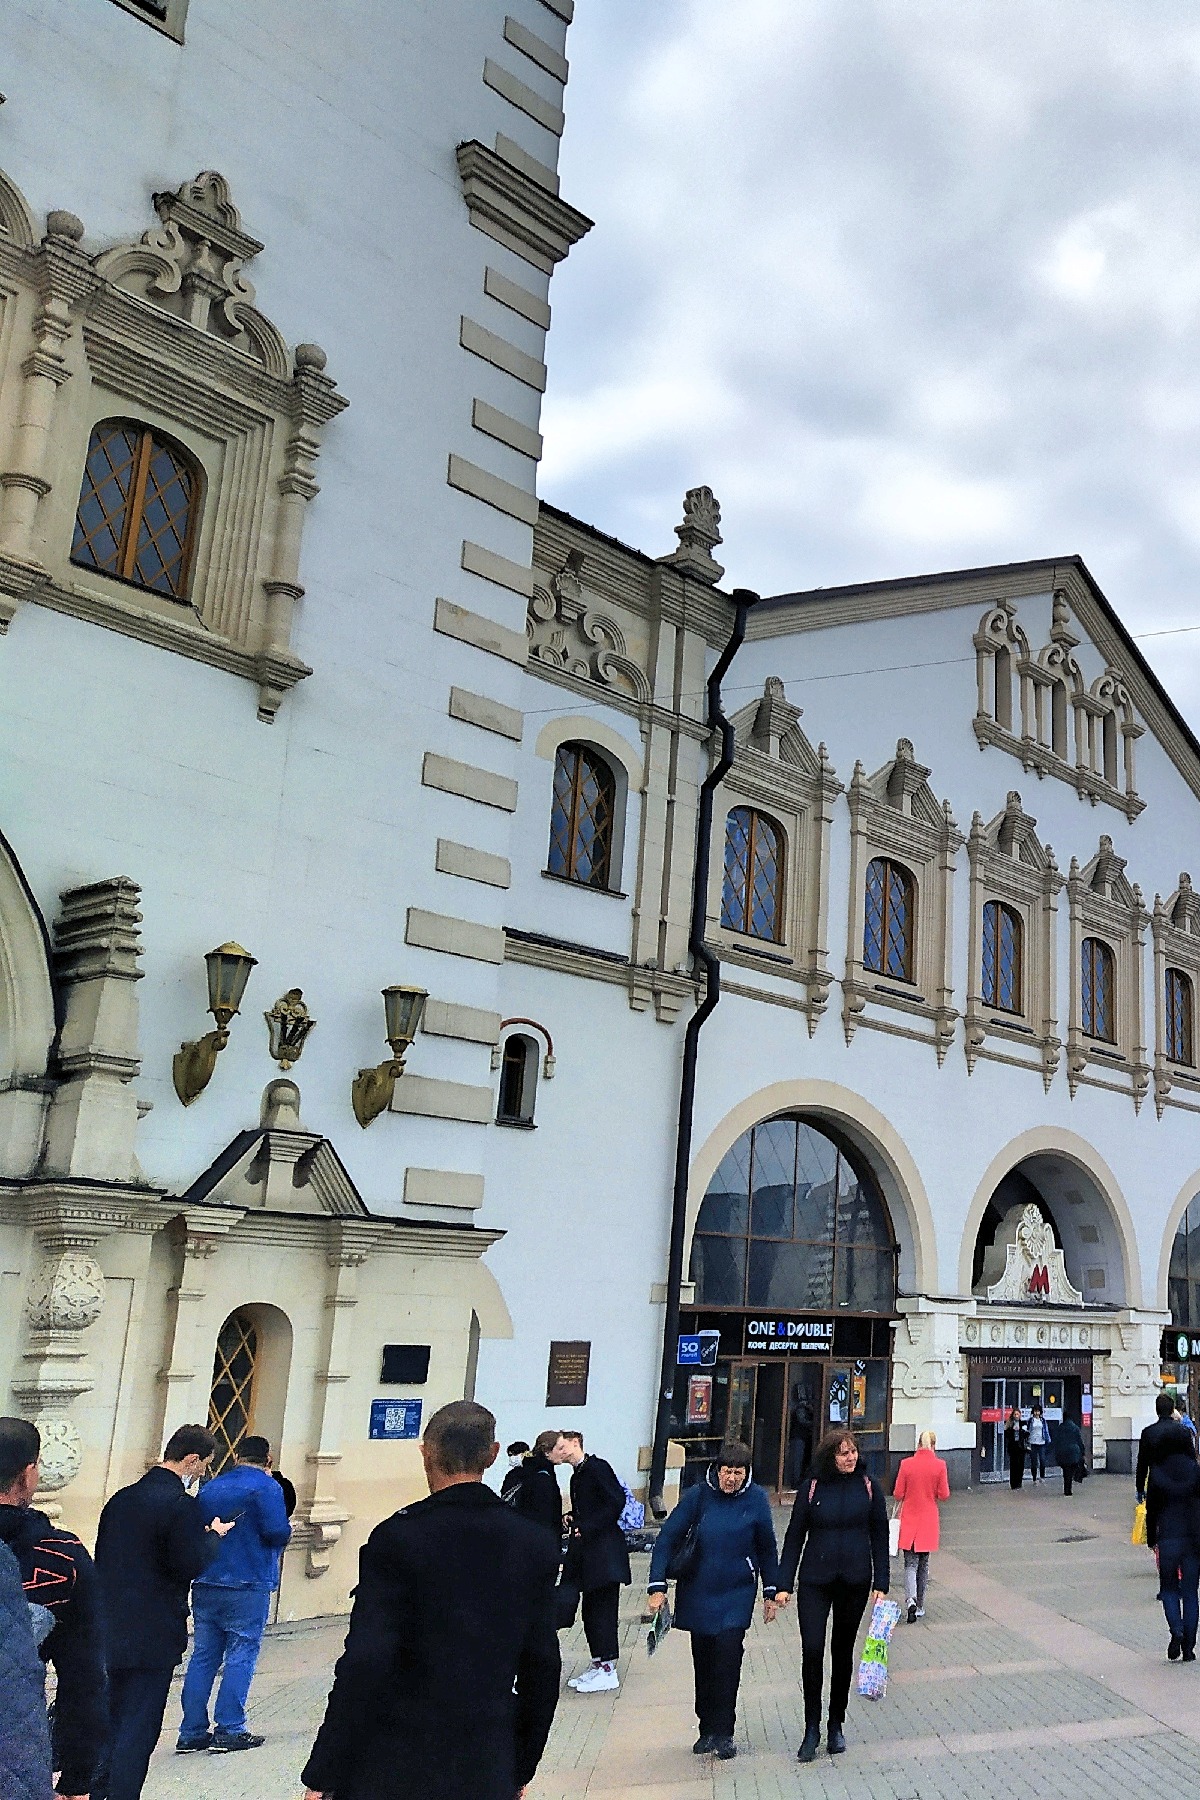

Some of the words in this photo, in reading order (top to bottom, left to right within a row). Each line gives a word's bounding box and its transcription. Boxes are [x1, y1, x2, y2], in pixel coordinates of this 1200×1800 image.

[1028, 1264, 1050, 1294] М
[748, 1321, 776, 1335] ONE
[777, 1322, 785, 1336] &
[787, 1322, 833, 1336] DOUBLE
[681, 1342, 698, 1352] 50
[768, 1342, 798, 1350] ДЕСЕРТЫ
